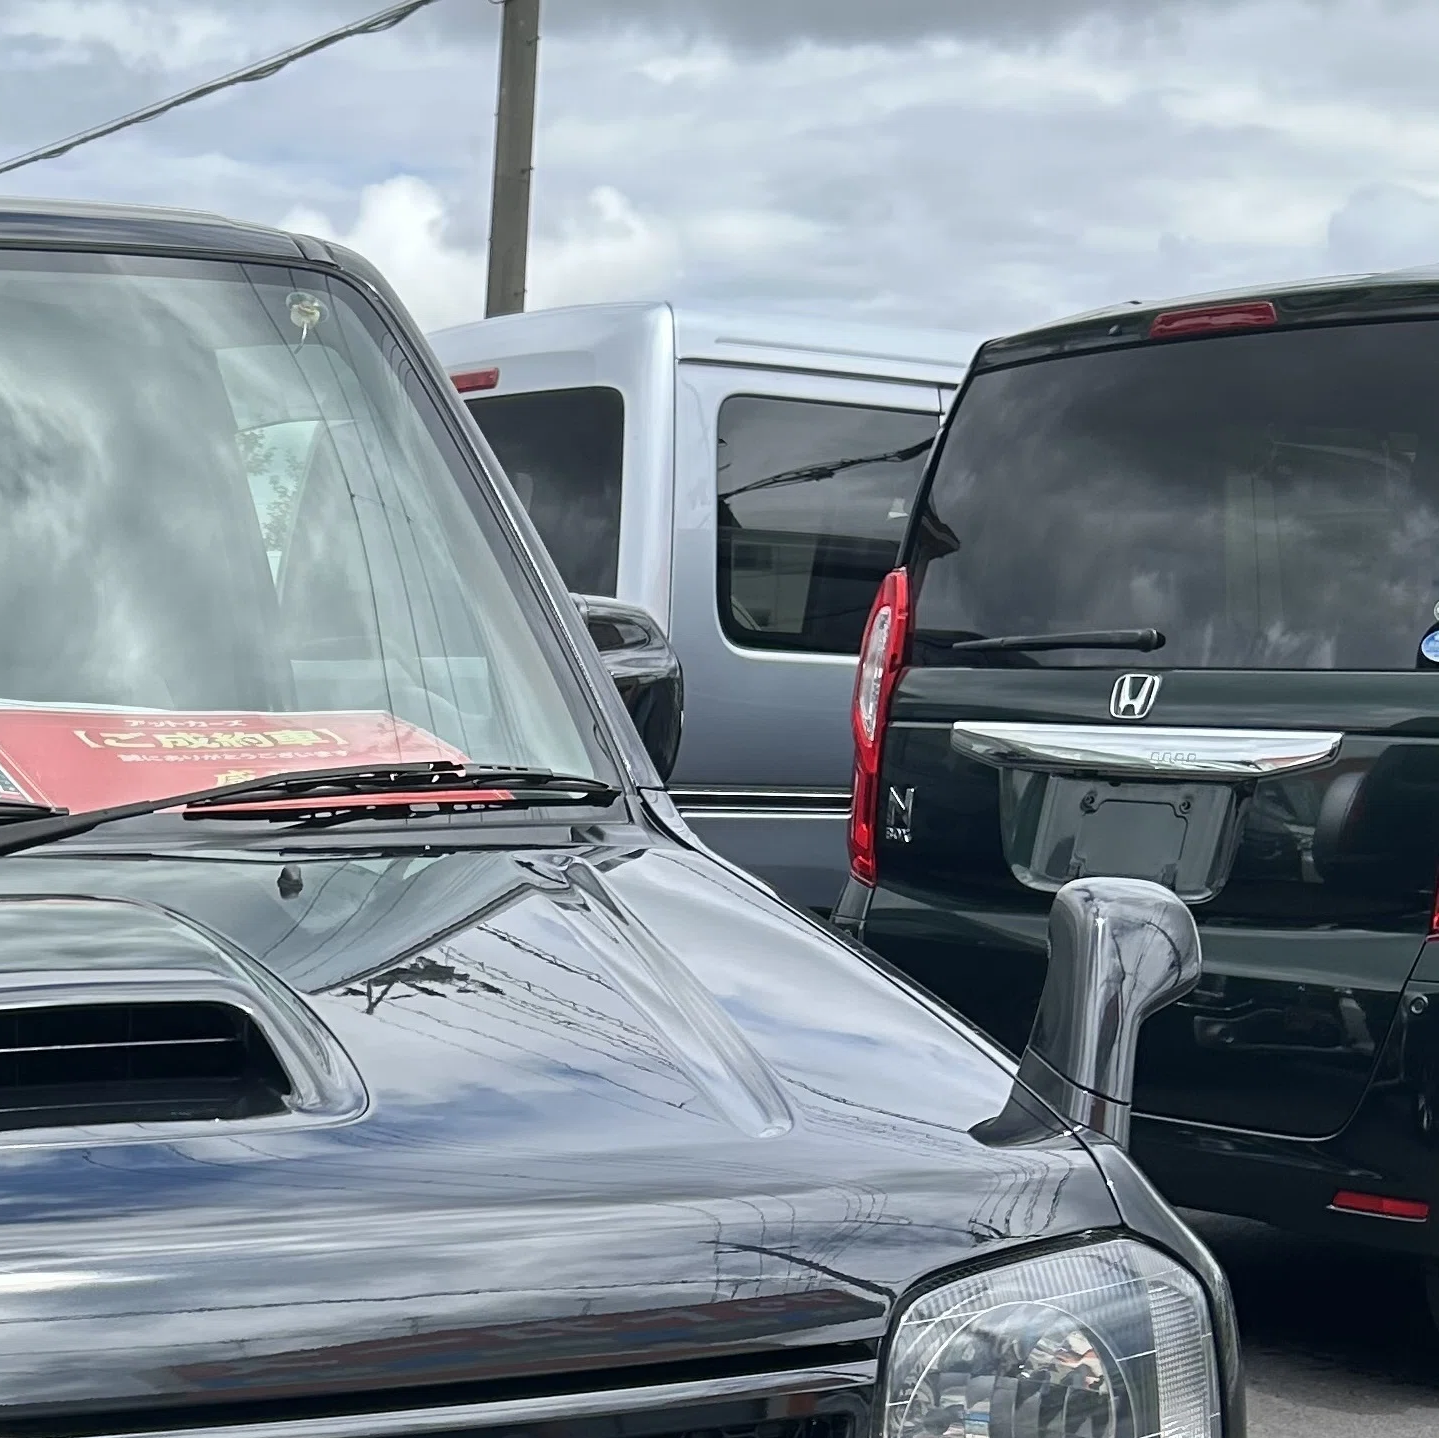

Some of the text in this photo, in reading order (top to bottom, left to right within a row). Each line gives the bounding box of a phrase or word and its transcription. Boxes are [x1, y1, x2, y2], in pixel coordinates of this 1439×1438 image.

[124, 719, 248, 728] アットカーズ
[886, 786, 915, 827] N
